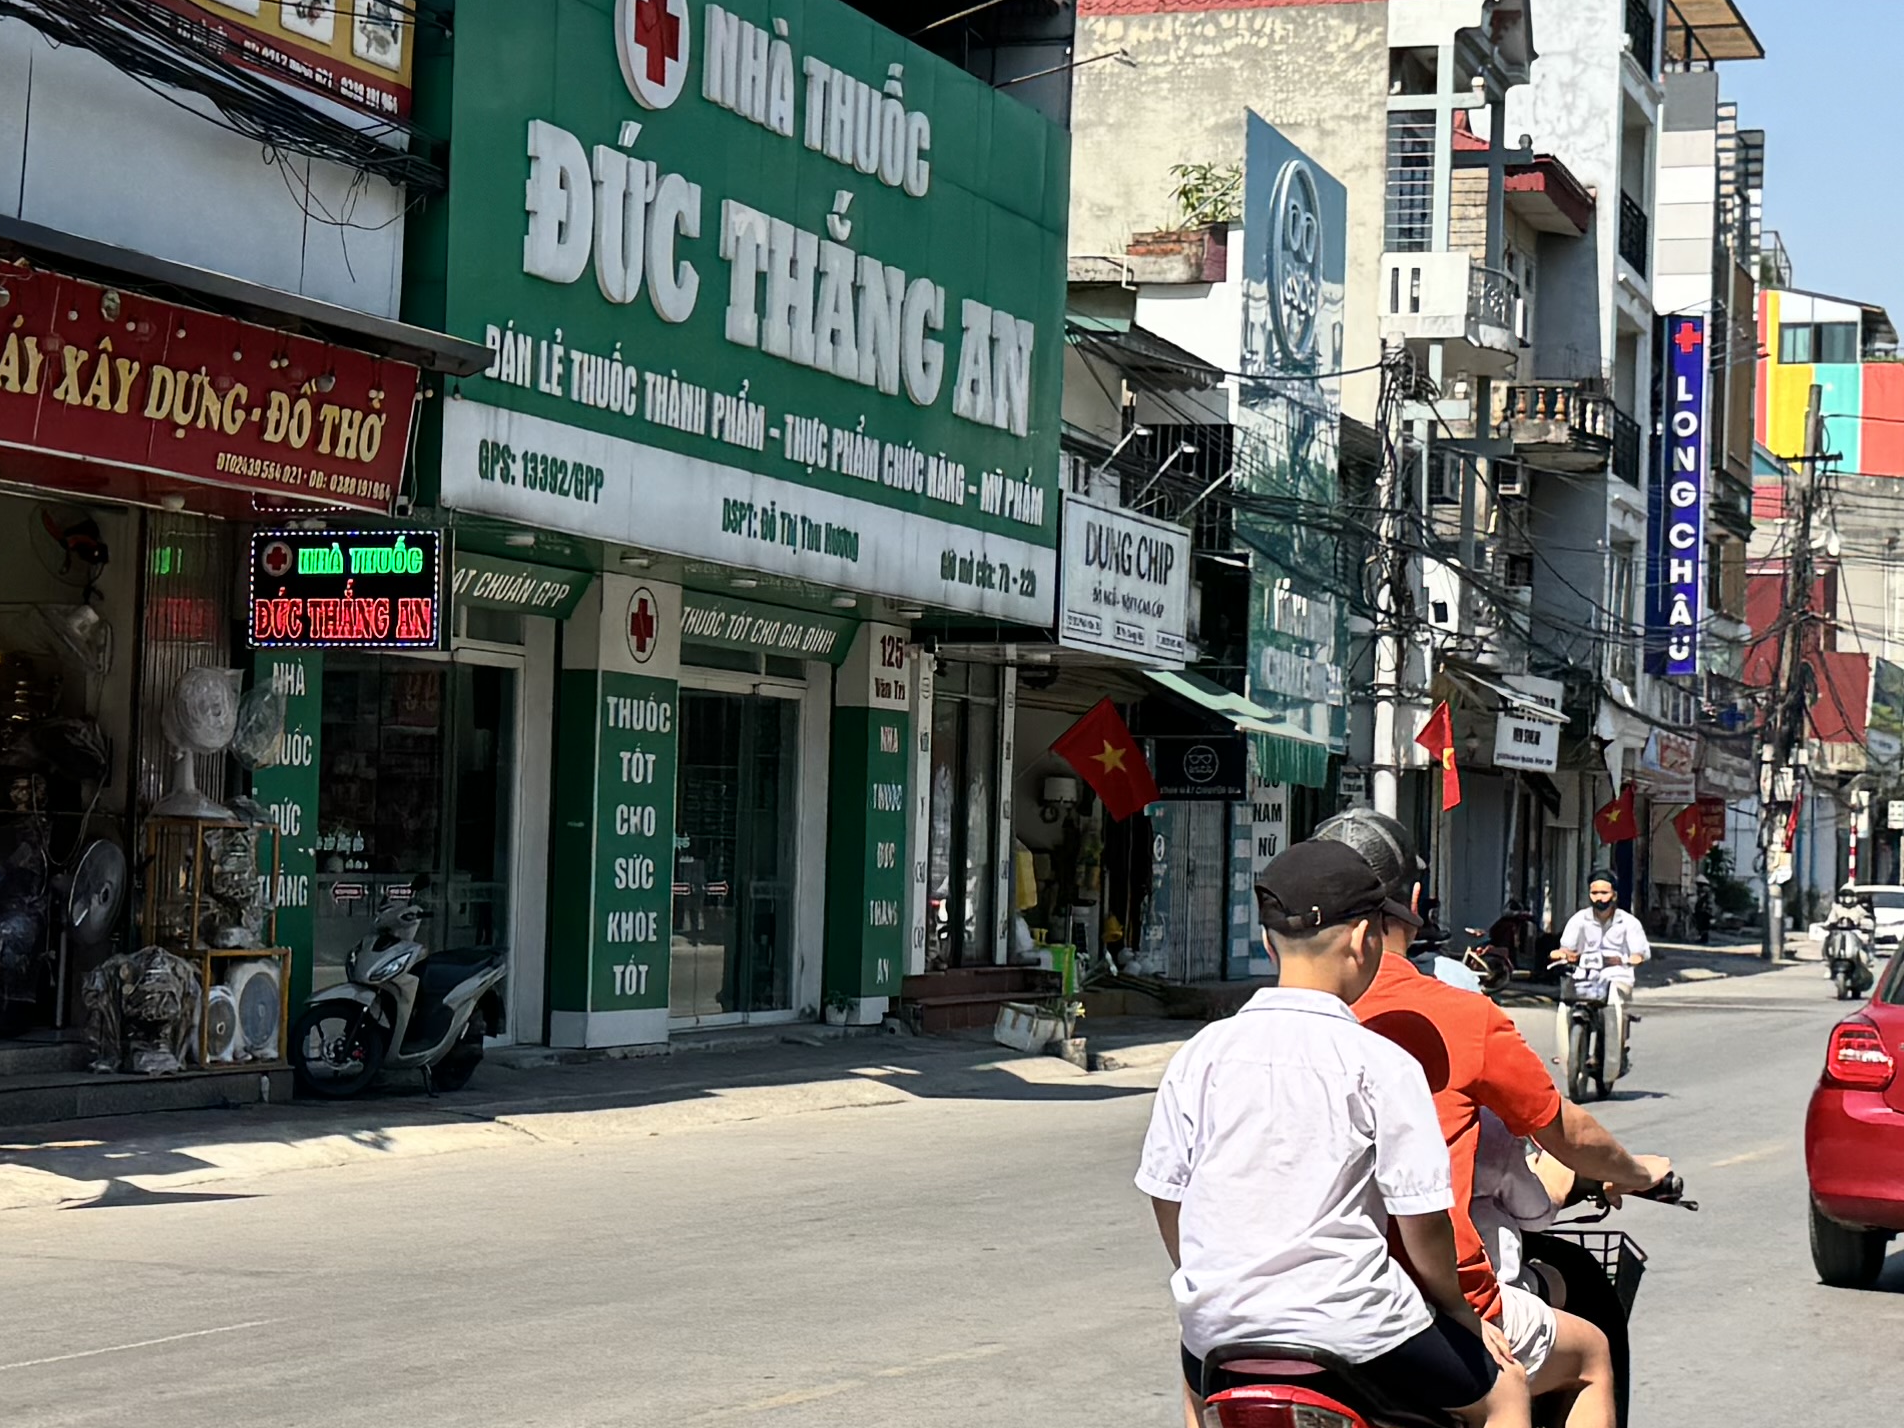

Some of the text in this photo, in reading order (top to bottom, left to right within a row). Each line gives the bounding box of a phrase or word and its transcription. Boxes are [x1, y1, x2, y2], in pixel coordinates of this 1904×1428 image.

[702, 3, 932, 199] NHÀ THUỐC
[523, 119, 1035, 438] ĐỨC THẮNG AN
[52, 336, 141, 414] XÂY
[144, 364, 249, 440] DỰNG
[263, 378, 318, 449] ĐỒ
[485, 319, 532, 388] BÁN
[539, 327, 563, 397] LẺ
[570, 341, 637, 417] THUỐC
[644, 369, 707, 436] THÀNH
[711, 379, 766, 451] PHẨM
[784, 413, 828, 475] THỰC
[831, 414, 879, 482] PHẨM
[883, 440, 924, 494] CHỨC
[927, 451, 965, 506] NĂNG
[1004, 466, 1044, 527] PHẨM
[478, 438, 517, 486] GPS:
[1668, 376, 1698, 661] LONG CHÂU
[298, 535, 424, 574] NHÀ THUỐC
[1085, 521, 1174, 585] DUNG CHIP
[255, 578, 432, 639] ĐỨC THẮNG AN
[531, 581, 571, 608] GPP
[680, 602, 726, 638] THUỐC
[725, 609, 753, 640] TỐT
[750, 618, 780, 646] CHO
[779, 623, 802, 650] GIA
[880, 635, 904, 670] 125
[272, 658, 306, 696] NHÀ
[607, 691, 671, 733] THUỐC
[619, 742, 656, 784] TỐT
[615, 803, 656, 837] CHO
[1253, 803, 1282, 822] NAM
[614, 853, 654, 891] SỨC
[613, 954, 649, 997] TỐT
